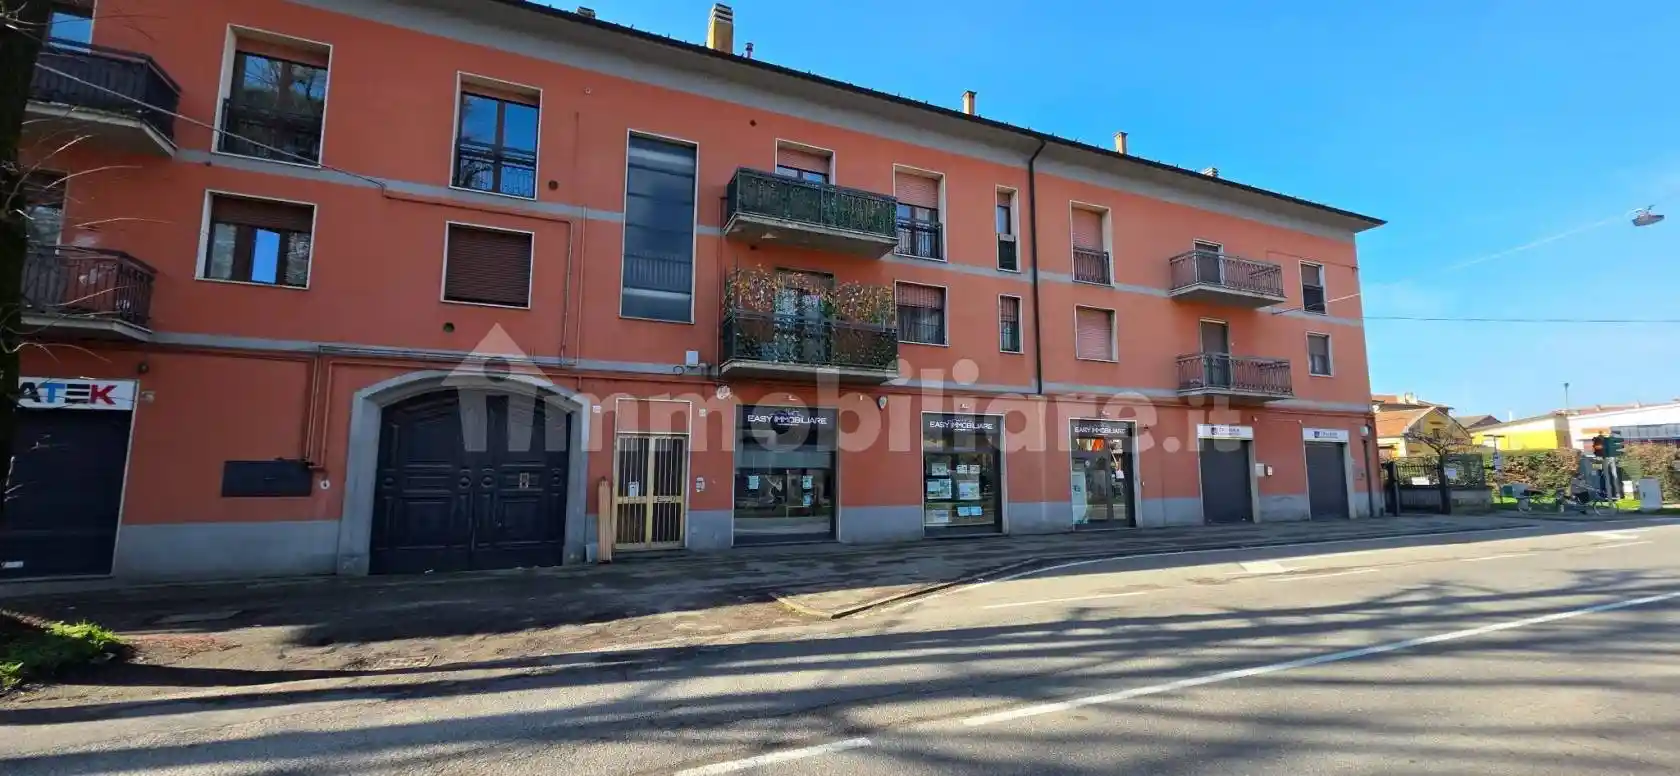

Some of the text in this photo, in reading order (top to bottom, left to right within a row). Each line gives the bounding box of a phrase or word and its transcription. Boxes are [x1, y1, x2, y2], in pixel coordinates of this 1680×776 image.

[747, 414, 772, 423] EASY
[773, 416, 828, 425] IMMOBILIARE
[929, 420, 950, 429] EASY
